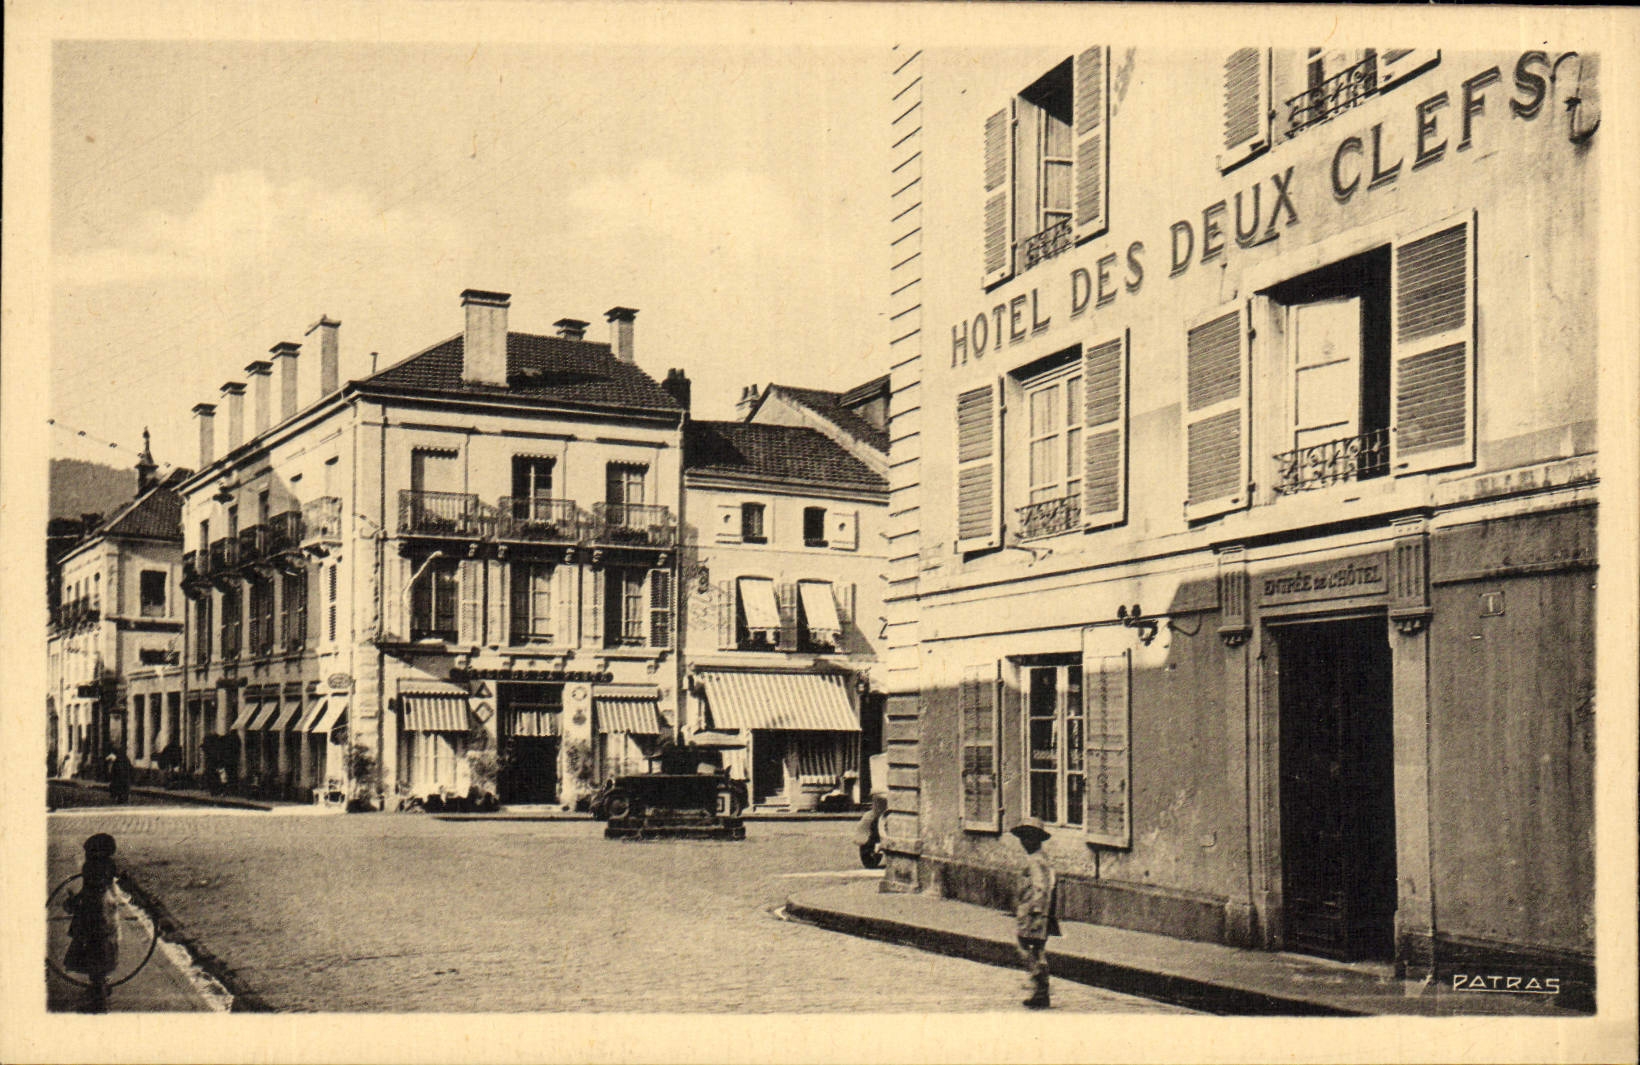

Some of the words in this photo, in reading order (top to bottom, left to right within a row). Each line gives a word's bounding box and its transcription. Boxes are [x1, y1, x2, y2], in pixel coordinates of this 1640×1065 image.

[951, 289, 1051, 369] HOTEL
[1069, 240, 1145, 320] DES
[1169, 165, 1300, 279] DEUX
[1331, 50, 1549, 205] CLEFS
